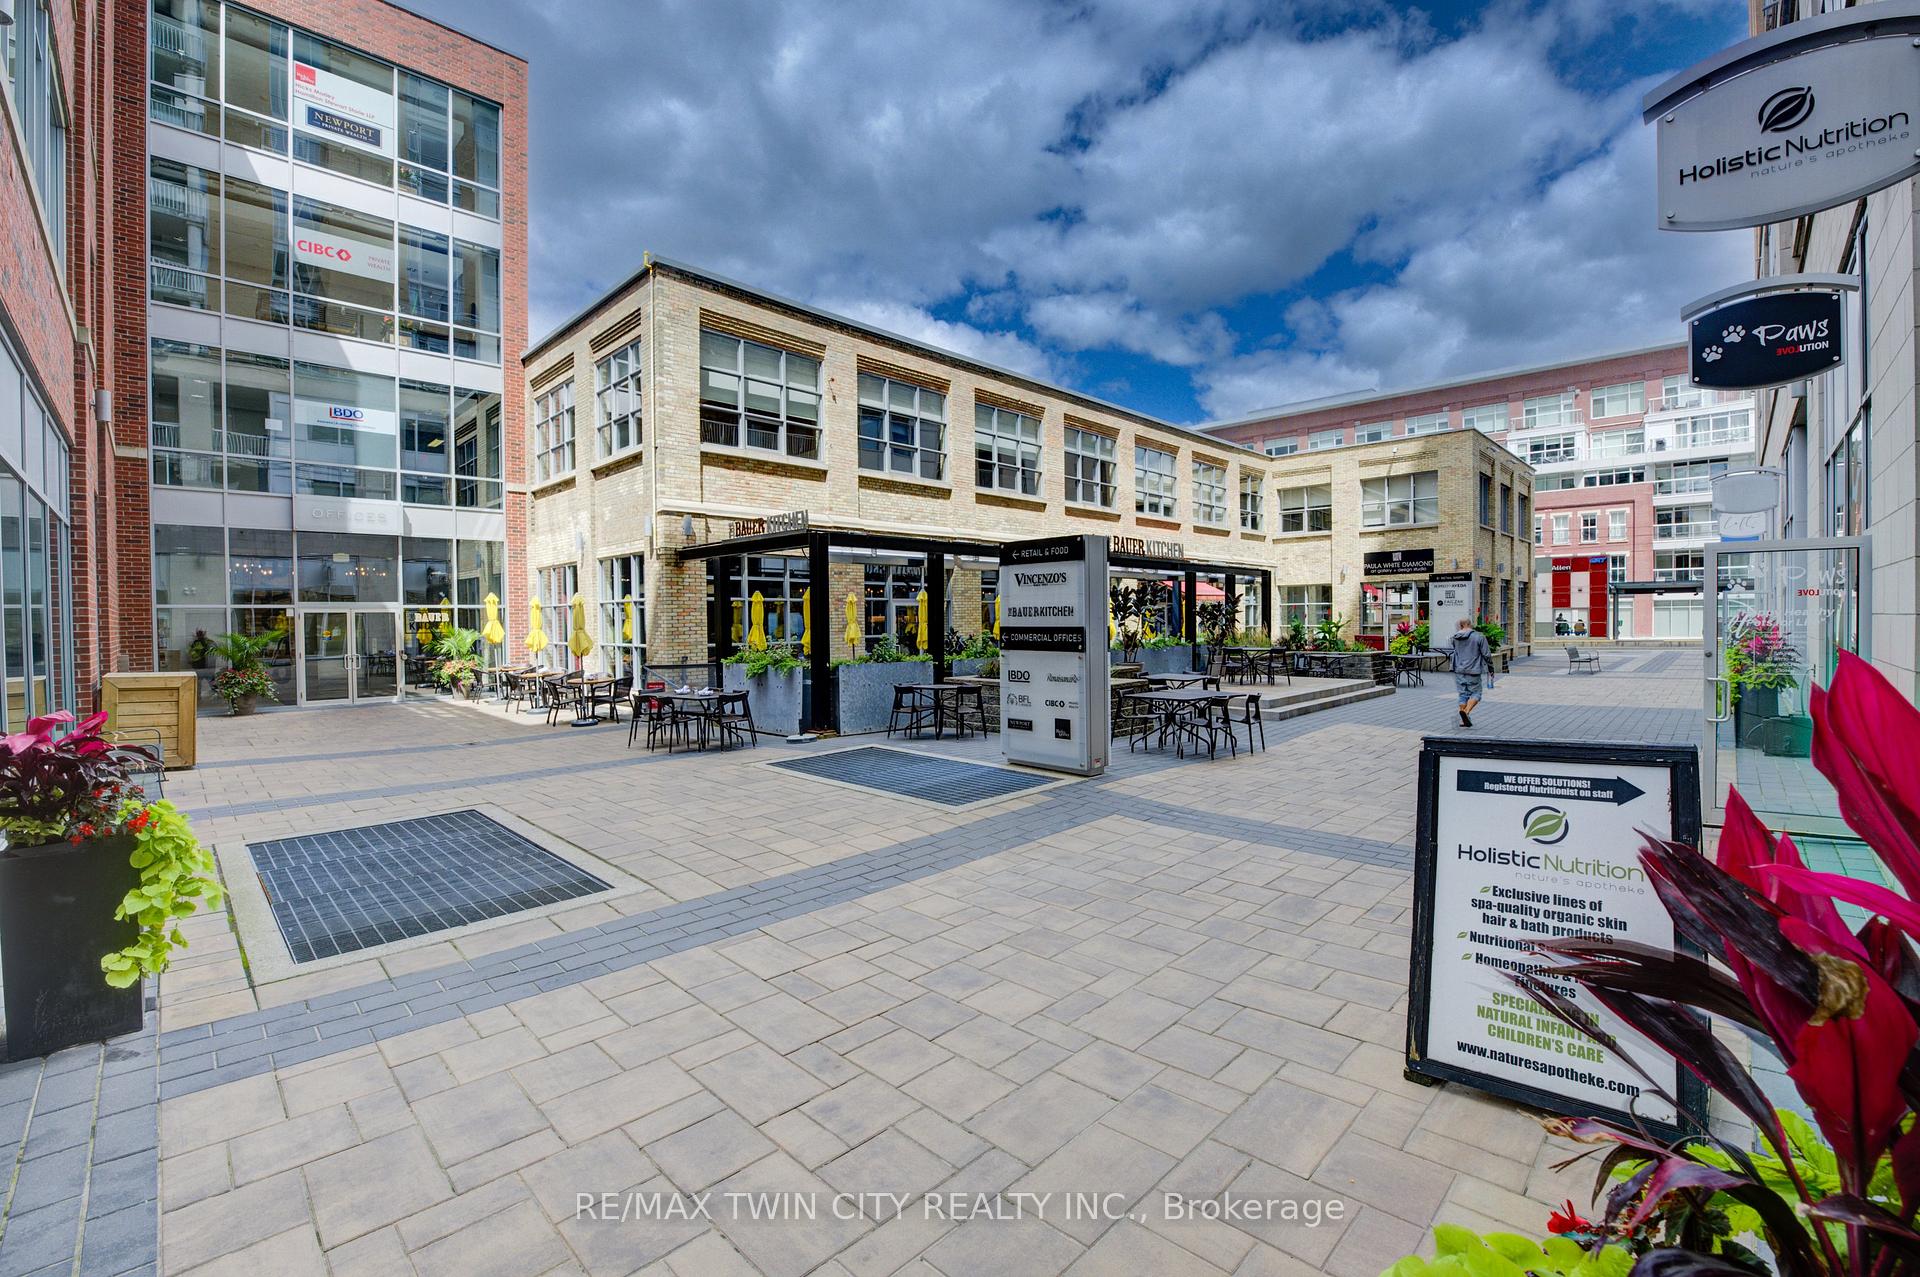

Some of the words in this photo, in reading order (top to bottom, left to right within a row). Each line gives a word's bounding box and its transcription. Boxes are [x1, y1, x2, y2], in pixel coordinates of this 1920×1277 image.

[314, 112, 374, 137] NEWPORT
[321, 122, 344, 132] PRIVATE
[1679, 146, 1781, 185] Holistic
[1786, 112, 1909, 157] Nutrition
[1750, 155, 1817, 179] nature's
[1825, 131, 1910, 159] apotheke
[297, 239, 334, 258] CIBC
[333, 407, 364, 419] BDO
[312, 508, 386, 523] OFFICES
[735, 518, 765, 537] BAUER
[766, 509, 809, 534] KITCHEN
[1021, 549, 1043, 558] RETAIL
[1044, 548, 1050, 556] &
[1051, 546, 1069, 555] FOOD
[1113, 535, 1145, 556] BAUER
[1147, 540, 1184, 560] KITCHEN
[1382, 561, 1401, 569] WHITE
[1402, 560, 1434, 568] DIAMOND
[414, 612, 450, 622] BAUER
[1010, 633, 1052, 642] COMMERCIAL
[1053, 633, 1082, 642] OFFICES
[1010, 670, 1031, 681] BDO
[1018, 694, 1031, 704] BFL
[1045, 699, 1059, 708] CIBC
[1484, 782, 1528, 793] Registered
[1530, 784, 1578, 797] Nutritionist
[1579, 789, 1591, 797] on
[1592, 789, 1613, 799] staff
[1503, 775, 1516, 784] WE
[1518, 776, 1541, 785] OFFER
[1542, 777, 1591, 789] SOLUTIONS!
[1458, 844, 1540, 869] Holistic
[1544, 853, 1644, 882] Nutrition
[1515, 871, 1570, 886] nature's
[1576, 879, 1645, 895] apotheke
[1492, 885, 1550, 904] Exclusive
[1553, 893, 1586, 910] lines
[1589, 900, 1603, 912] of
[1471, 898, 1540, 919] spa-quality
[1543, 908, 1594, 926] organic
[1597, 916, 1627, 931] skin
[1482, 912, 1507, 927] hair
[1509, 918, 1518, 929] &
[1521, 919, 1550, 934] bath
[1552, 925, 1613, 945] products
[1469, 931, 1535, 952] Nutritional
[1477, 1005, 1533, 1030] NATURAL
[1536, 1017, 1582, 1041] INFANT
[1487, 1023, 1564, 1054] CHILDREN'S
[1567, 1042, 1604, 1063] CARE
[1457, 1041, 1640, 1097] www.naturesapotheke.com
